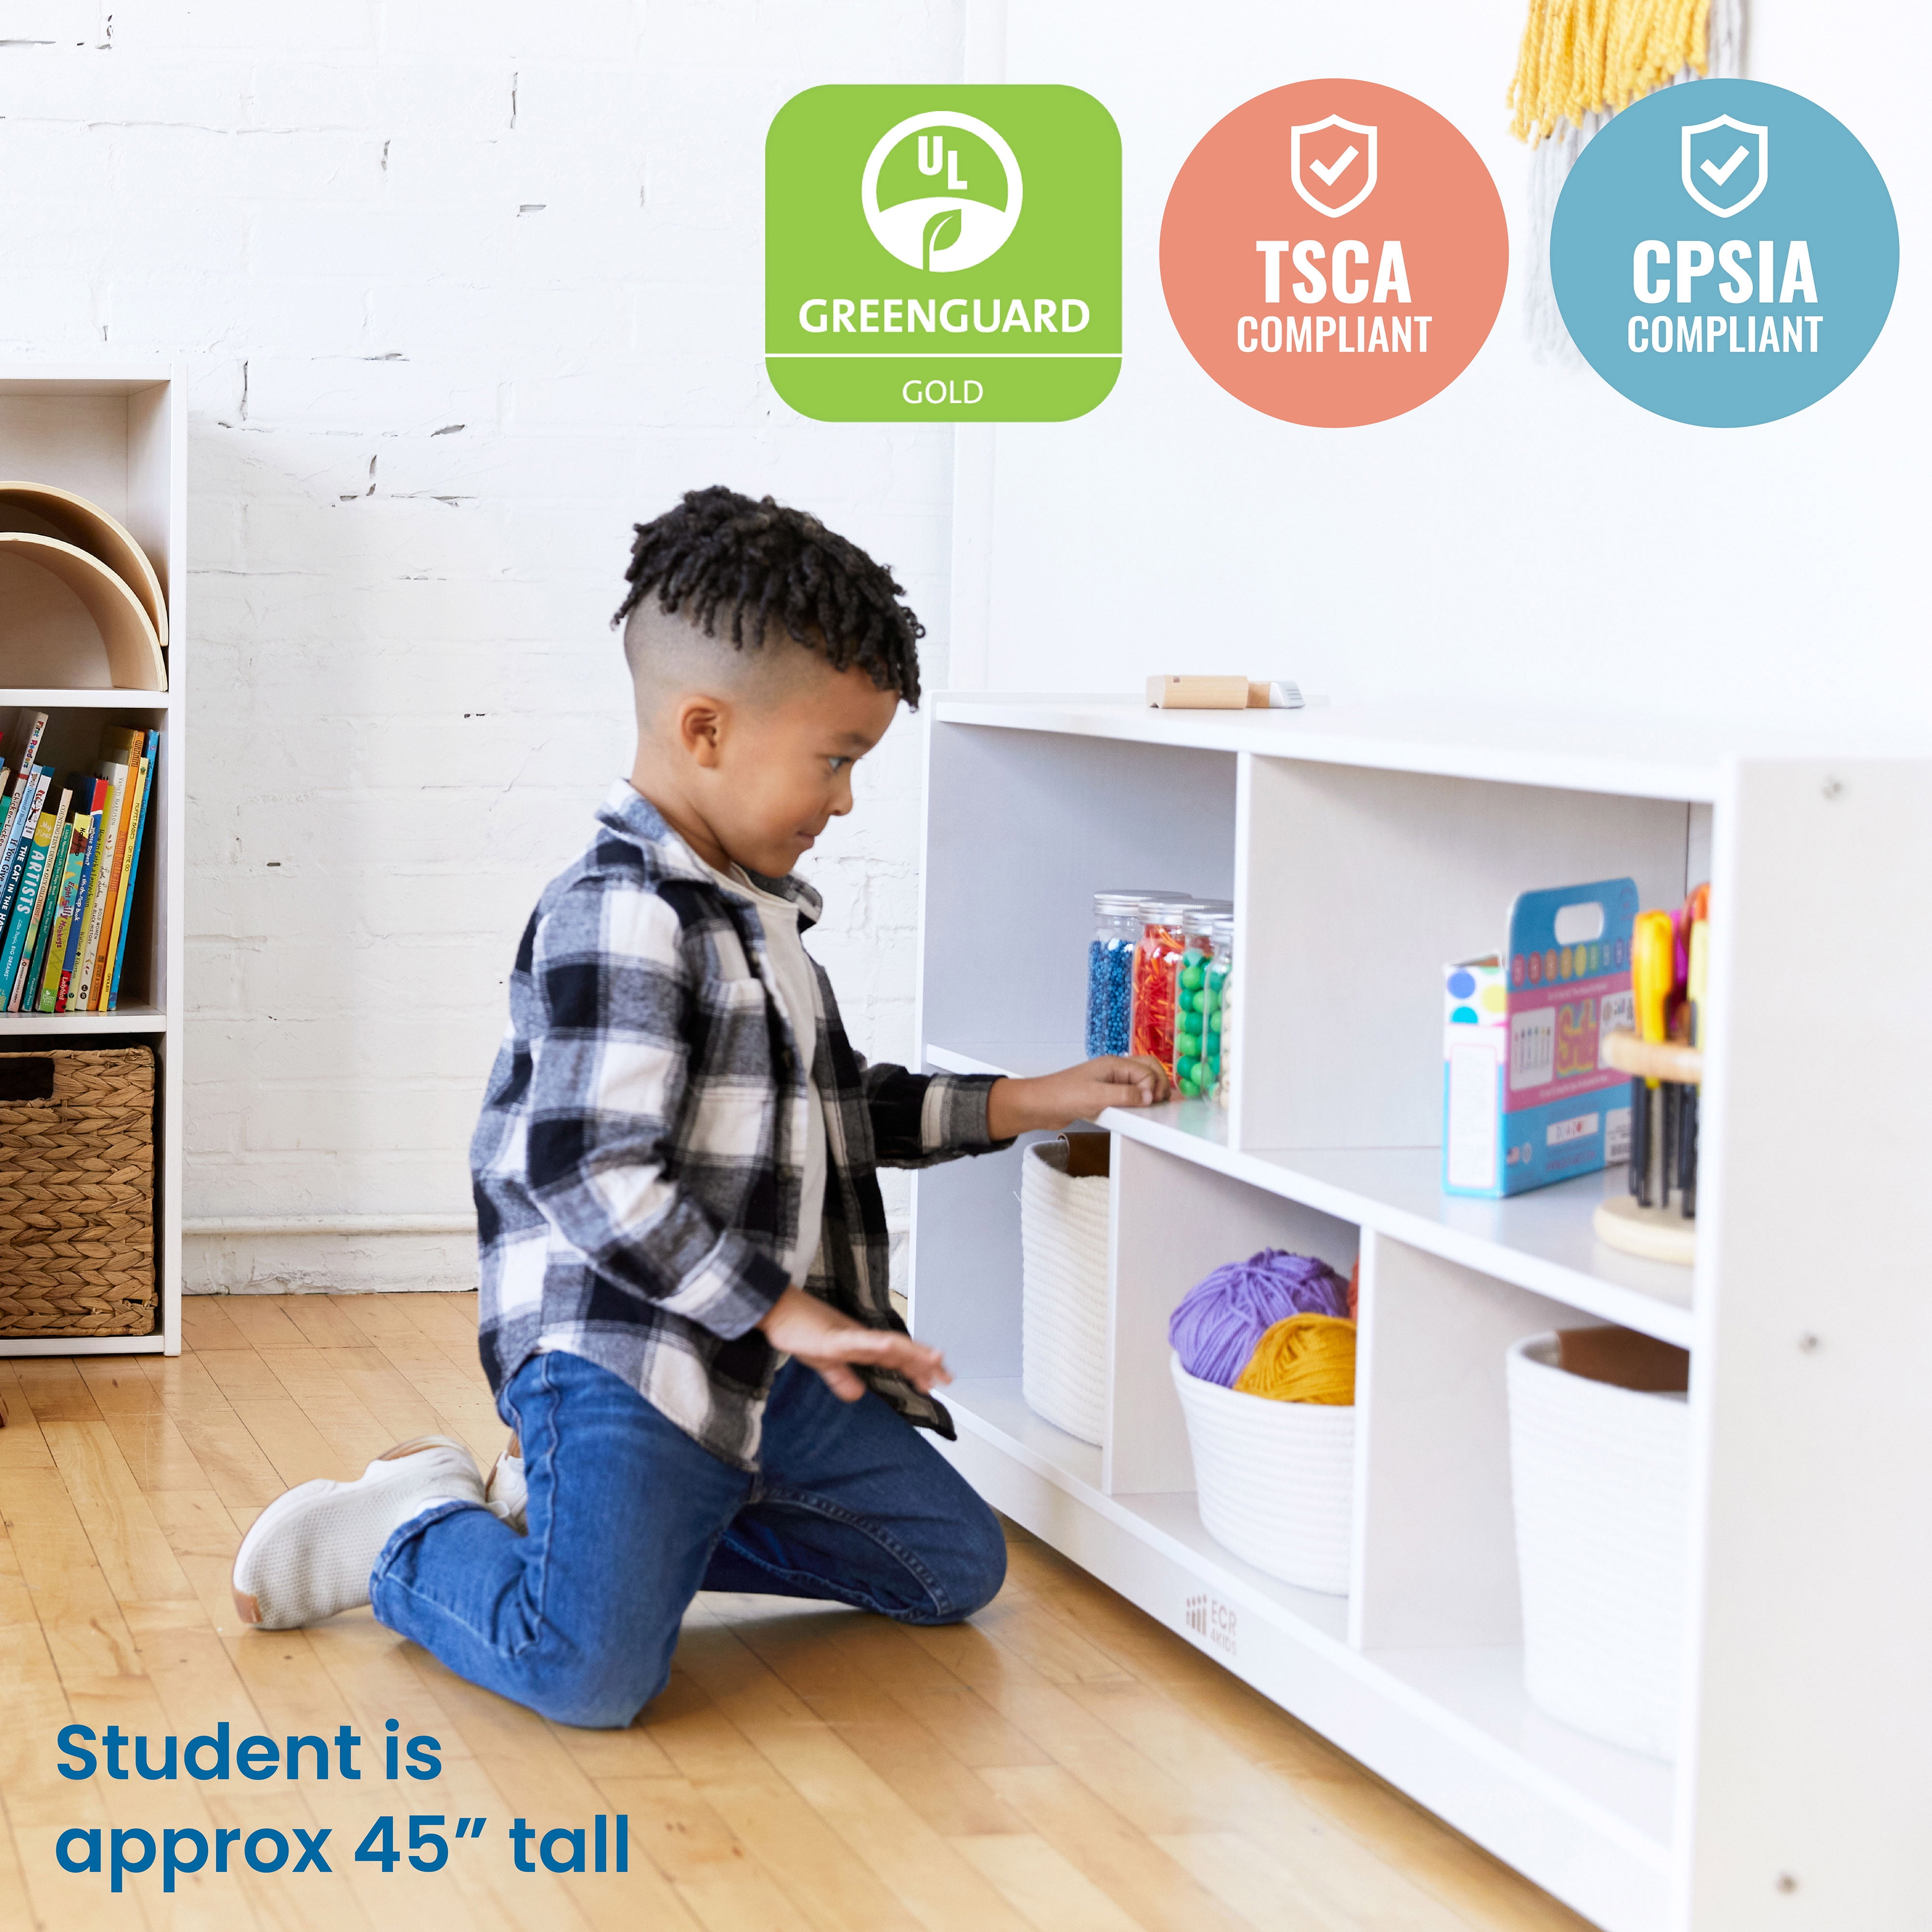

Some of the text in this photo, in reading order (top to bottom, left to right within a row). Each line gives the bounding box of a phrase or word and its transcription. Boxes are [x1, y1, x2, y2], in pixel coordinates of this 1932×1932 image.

[23, 721, 44, 768] First Readers
[115, 778, 124, 796] VASHTI
[22, 789, 32, 811] Numeroff
[54, 805, 66, 835] COUNTING
[111, 798, 120, 825] HARRISON
[10, 838, 18, 847] If
[50, 835, 58, 850] TINY
[4, 848, 15, 862] You
[17, 846, 28, 862] THE
[46, 850, 55, 868] DINOS
[84, 845, 93, 866] Stripes?
[12, 865, 21, 882] CAT
[17, 850, 45, 914] ARTISTS
[8, 883, 14, 893] IN
[2, 896, 11, 910] THE
[34, 886, 46, 917] GILCHRIST
[53, 881, 75, 948] Eight Silly Monkeys
[72, 957, 80, 979] Elkerton
[59, 977, 68, 1000] Ladybird
[1211, 1599, 1236, 1636] ECR
